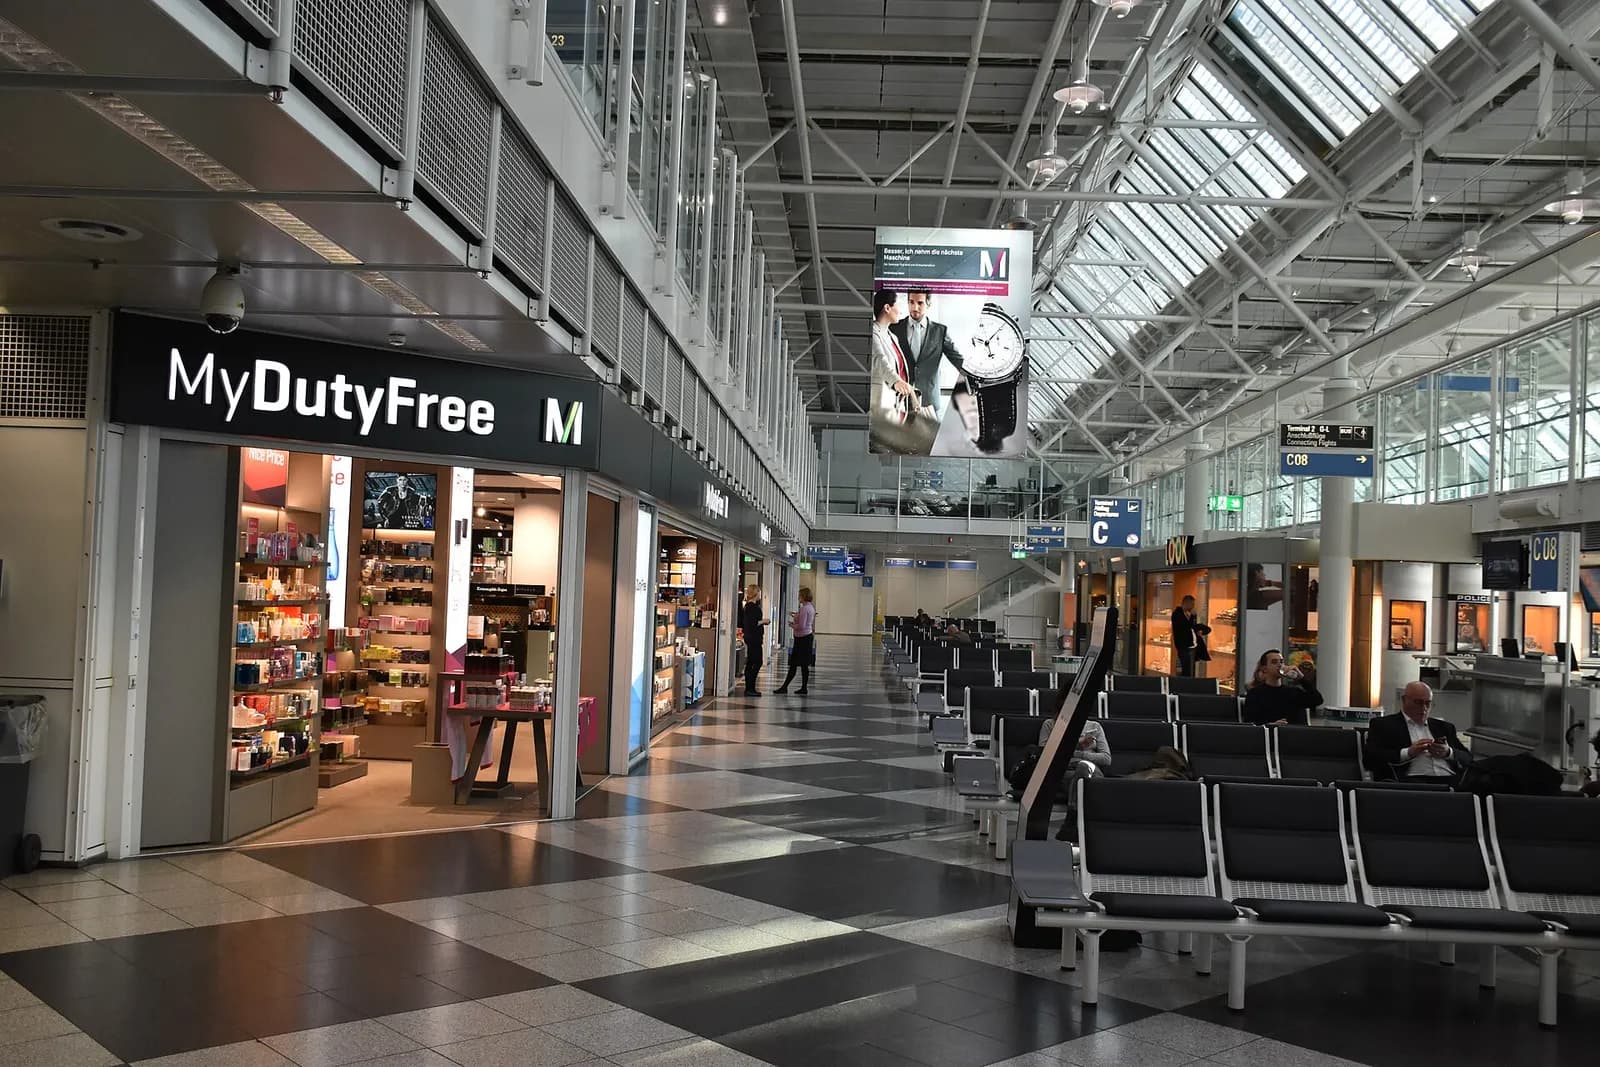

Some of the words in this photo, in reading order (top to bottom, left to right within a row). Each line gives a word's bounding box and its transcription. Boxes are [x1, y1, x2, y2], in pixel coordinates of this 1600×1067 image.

[551, 34, 565, 46] 23
[167, 347, 496, 436] MyDutyFree
[1286, 424, 1310, 432] Terminal
[1286, 439, 1318, 447] Connecting
[1318, 439, 1337, 447] Flights
[266, 450, 285, 466] Price
[1286, 453, 1308, 466] C08
[1092, 521, 1109, 544] C
[1165, 535, 1188, 566] LOOK
